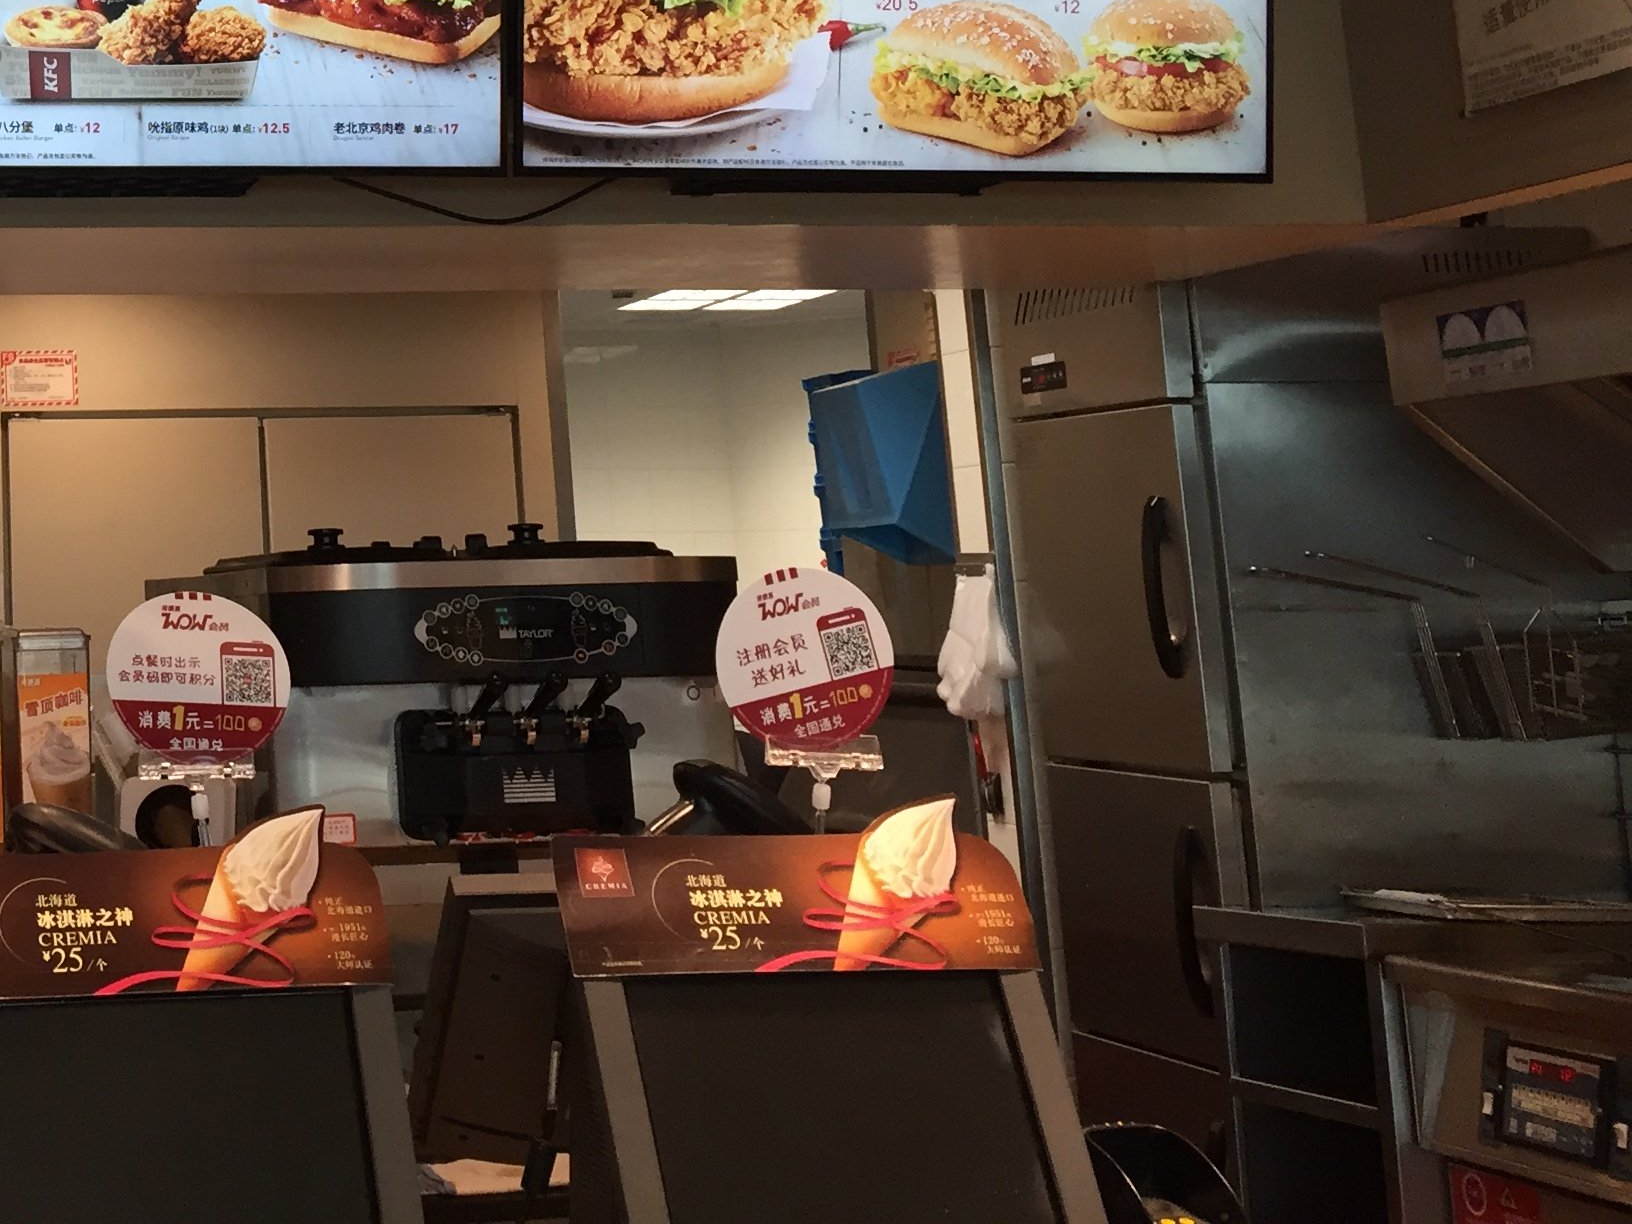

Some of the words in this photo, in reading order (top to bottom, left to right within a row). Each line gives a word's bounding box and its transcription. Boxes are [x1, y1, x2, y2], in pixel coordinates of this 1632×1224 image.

[43, 56, 59, 94] KFC
[333, 121, 406, 135] 老北京鸡肉卷
[518, 628, 554, 639] TAYLOR
[735, 633, 809, 667] 注册会员
[131, 654, 201, 668] 点餐时出示
[118, 670, 216, 687] 会员码即可积分
[751, 658, 807, 688] 送好礼
[24, 688, 84, 717] 雪顶咖啡
[585, 882, 628, 891] CREMIA
[686, 874, 727, 888] 北海道
[35, 893, 78, 908] 北海道
[688, 888, 784, 908] 冰淇淋之神
[36, 906, 134, 930] 冰淇淋之神
[693, 910, 771, 925] CREMIA
[38, 930, 117, 947] CREMIA
